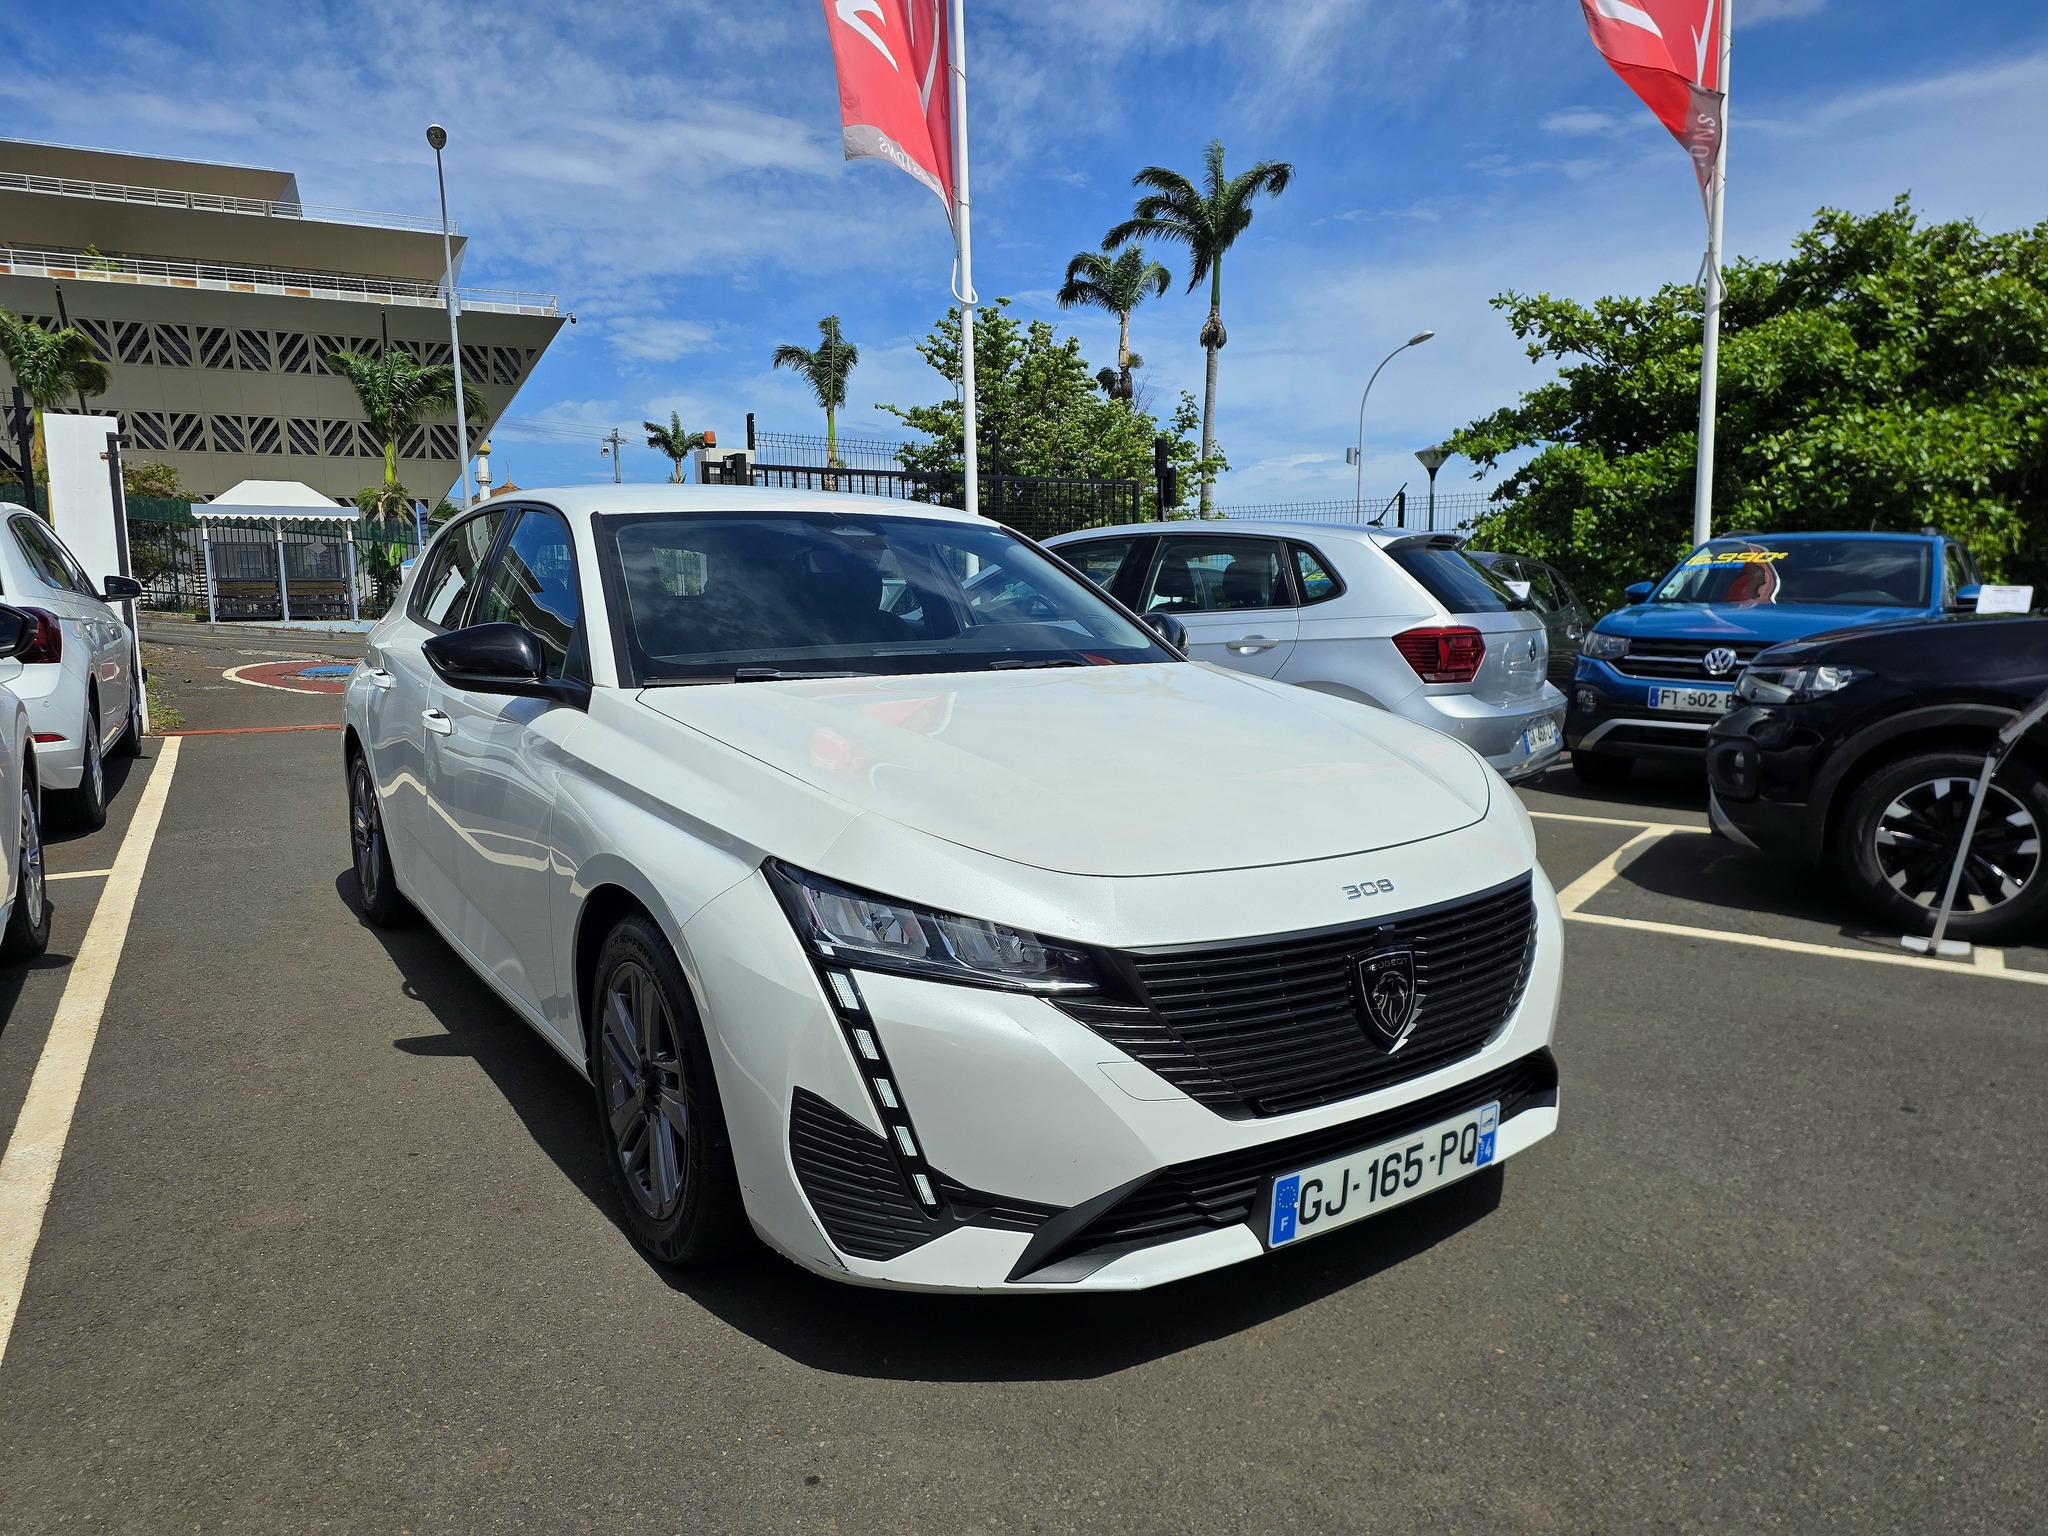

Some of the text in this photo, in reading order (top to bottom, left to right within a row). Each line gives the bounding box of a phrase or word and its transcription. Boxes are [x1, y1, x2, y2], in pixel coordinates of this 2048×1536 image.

[1688, 113, 1716, 168] ONS
[1341, 878, 1395, 901] 308
[1365, 957, 1409, 973] PEUGEOT
[1298, 1121, 1479, 1226] GJ-165-PQ
[1280, 1216, 1289, 1232] F
